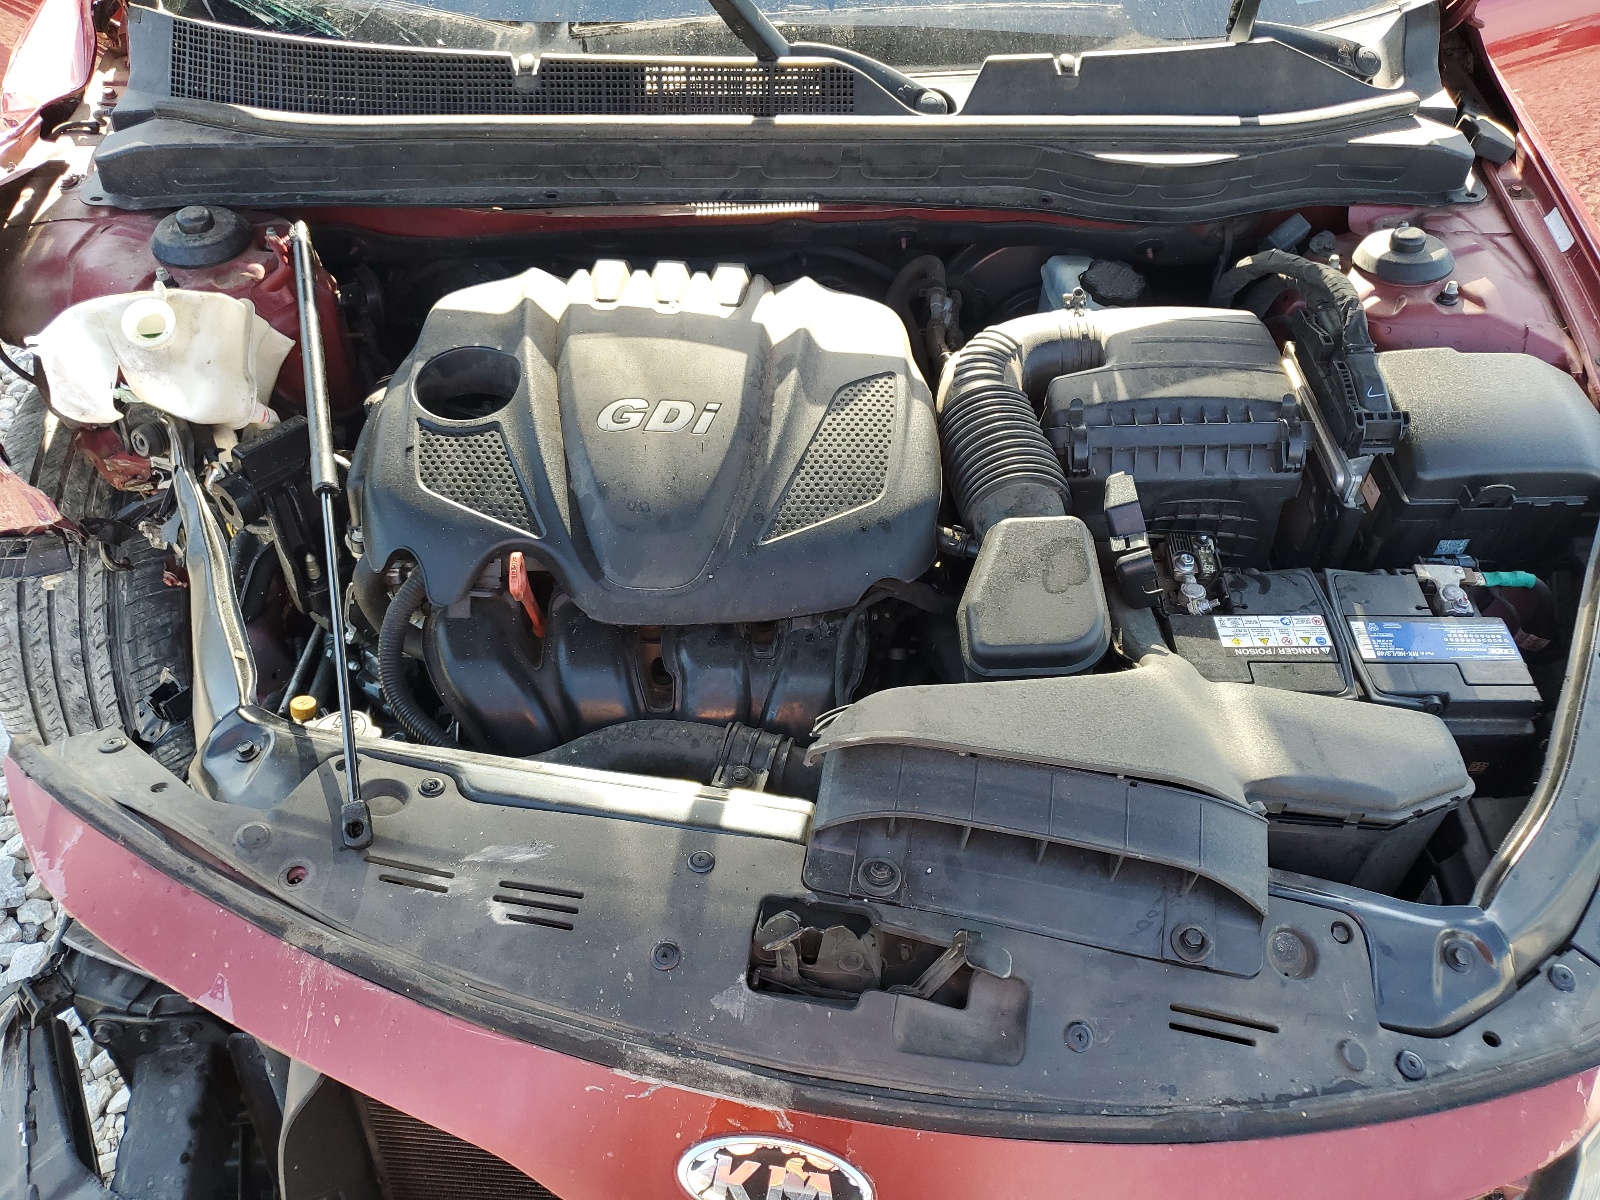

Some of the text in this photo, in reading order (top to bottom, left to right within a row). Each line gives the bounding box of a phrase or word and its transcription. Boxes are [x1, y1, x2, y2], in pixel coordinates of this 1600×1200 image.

[596, 397, 722, 435] GDi
[1234, 647, 1273, 656] POISON
[1279, 646, 1320, 656] DANGER
